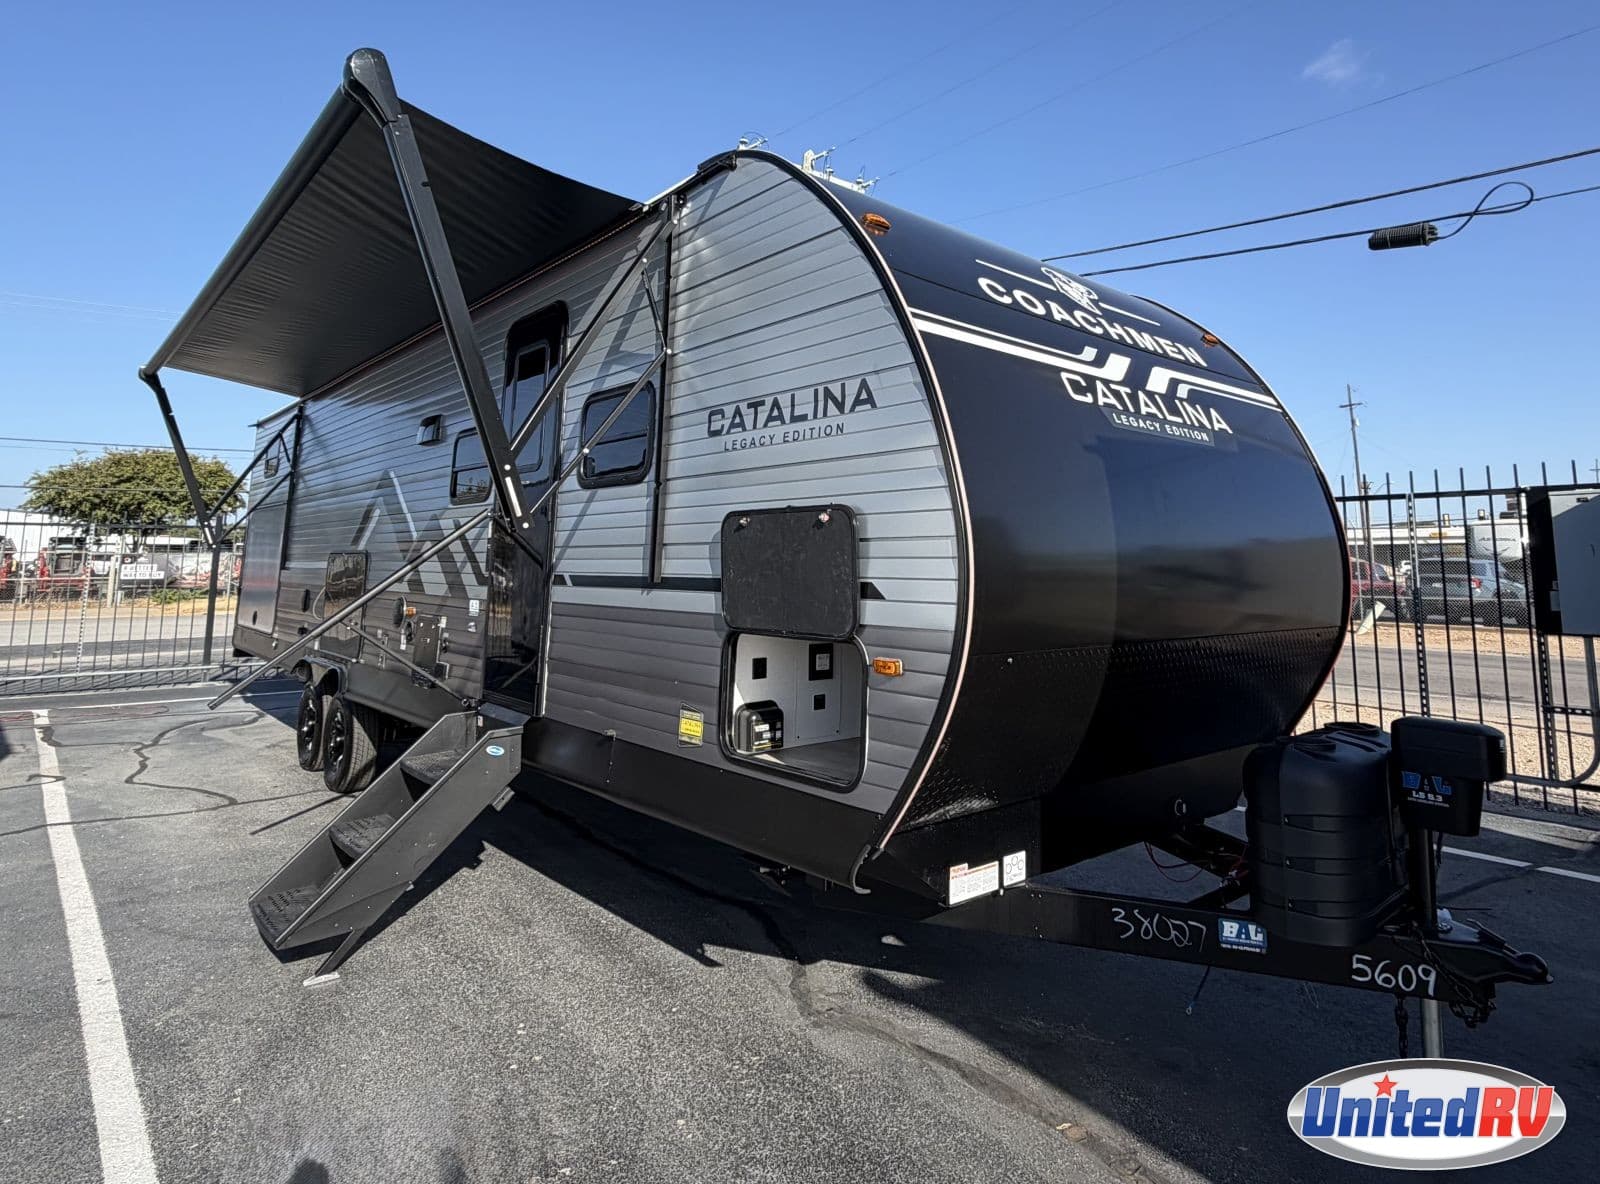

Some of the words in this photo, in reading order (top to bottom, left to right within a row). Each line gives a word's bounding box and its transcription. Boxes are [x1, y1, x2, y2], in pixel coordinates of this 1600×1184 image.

[977, 276, 1208, 367] COACHMEN
[707, 377, 878, 438] CATALINA
[1060, 371, 1233, 434] CATALINA
[724, 434, 776, 451] LEGACY
[782, 422, 845, 443] EDITION
[1112, 412, 1160, 432] LEGACY
[1165, 424, 1209, 442] EDITION
[1222, 921, 1264, 942] BAL
[1351, 954, 1437, 997] 5609
